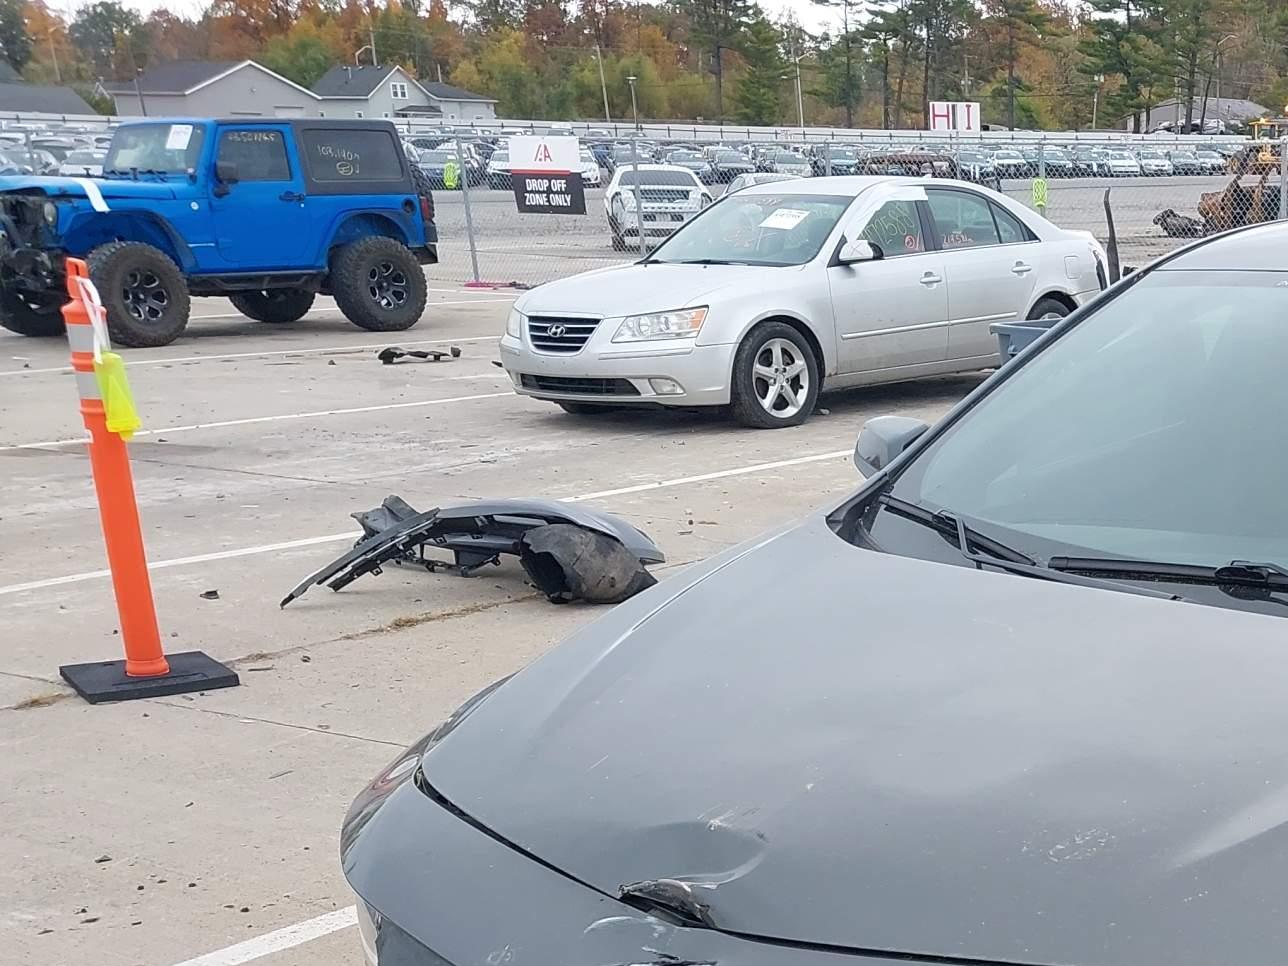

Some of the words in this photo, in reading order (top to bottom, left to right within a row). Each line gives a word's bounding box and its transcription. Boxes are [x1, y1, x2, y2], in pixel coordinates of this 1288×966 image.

[525, 178, 549, 191] DROP
[551, 179, 567, 192] OFF
[524, 193, 549, 206] ZONE
[549, 193, 571, 206] ONLY
